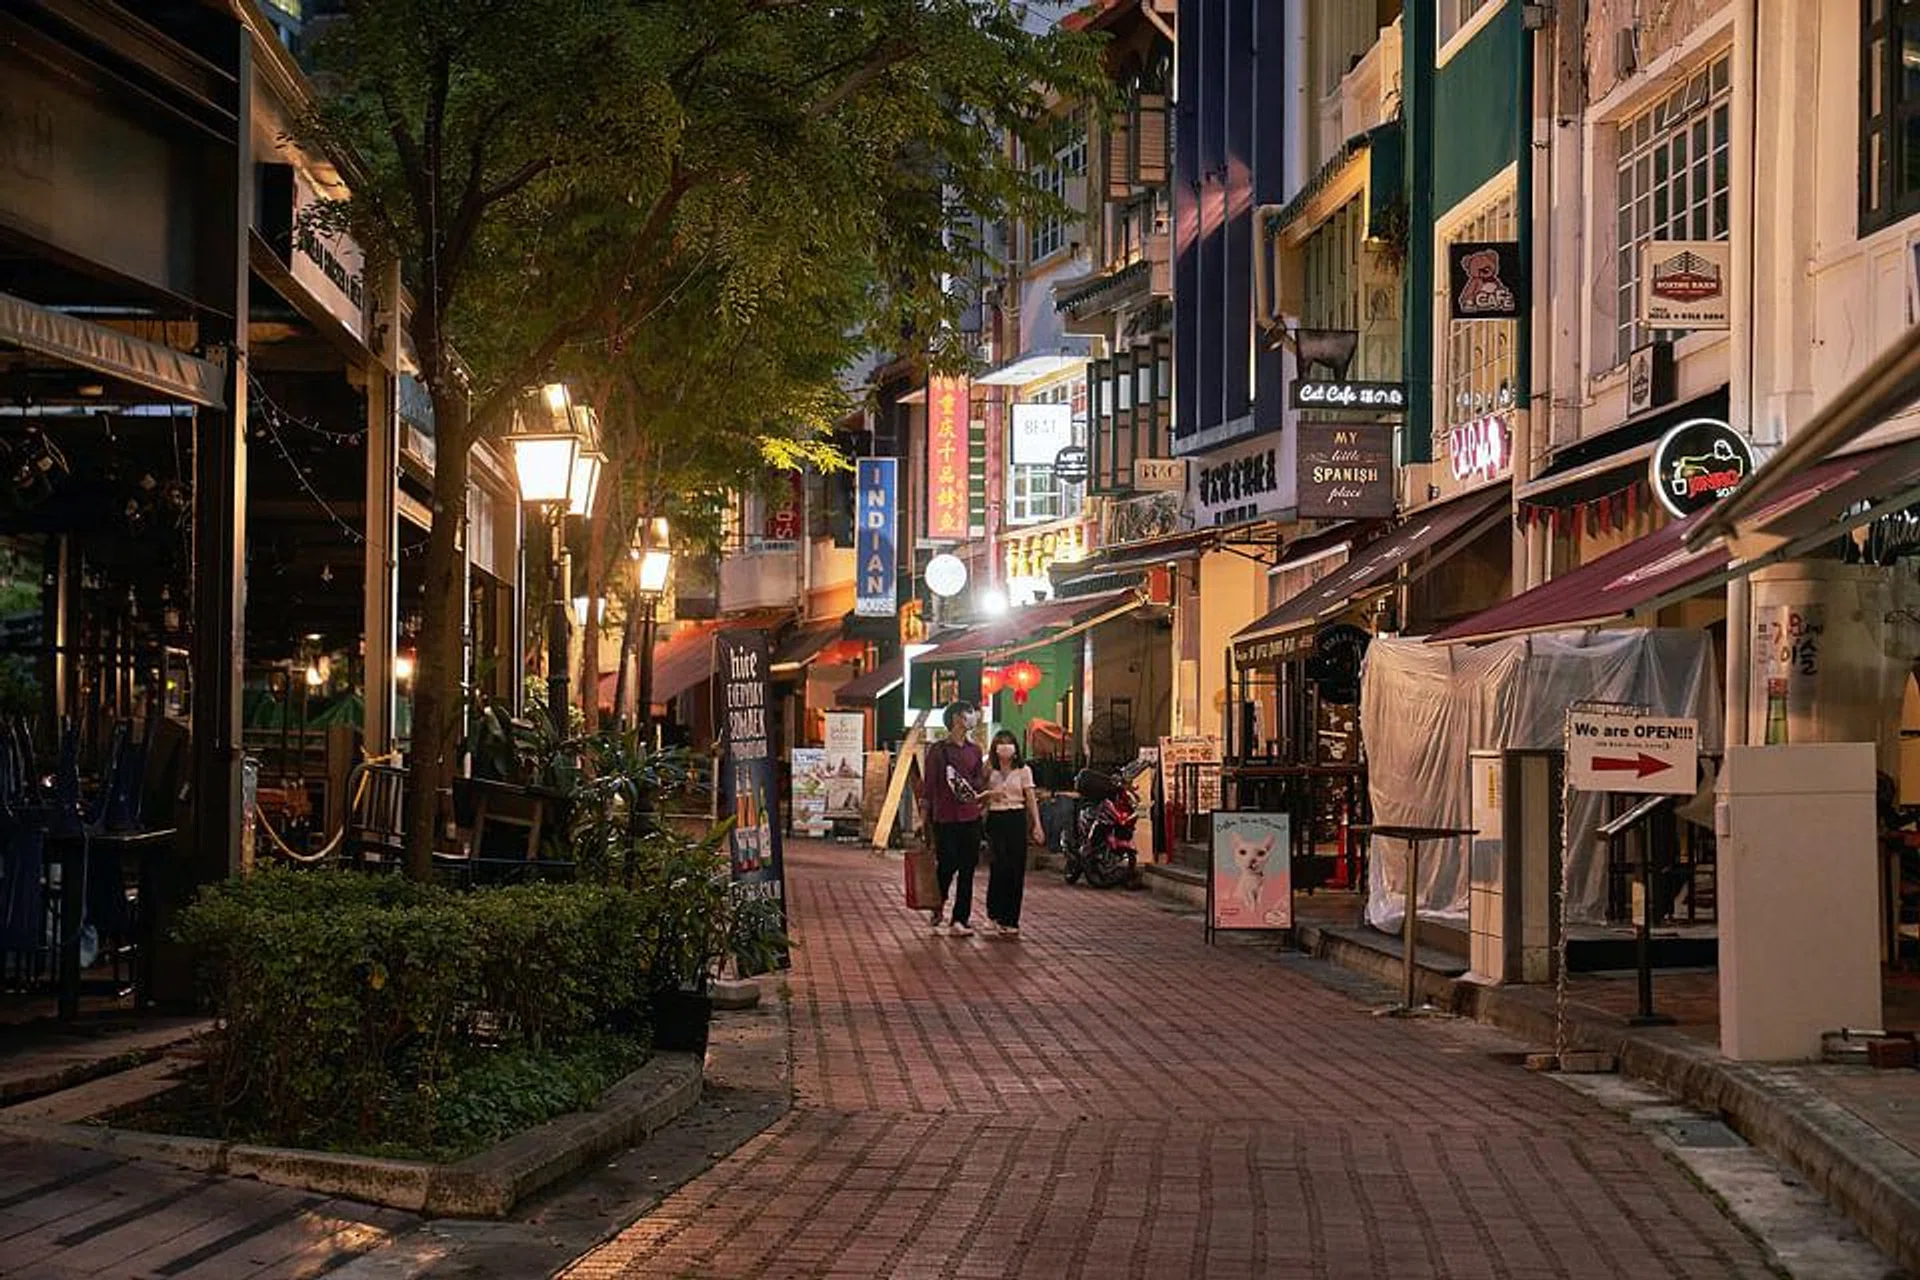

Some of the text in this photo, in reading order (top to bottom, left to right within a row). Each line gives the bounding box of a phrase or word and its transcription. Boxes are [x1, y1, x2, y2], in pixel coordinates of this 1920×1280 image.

[1334, 432, 1357, 444] MY
[1313, 466, 1378, 484] SPANISH
[1327, 486, 1361, 503] place
[867, 467, 886, 594] INDIAN
[1575, 722, 1694, 740] We are OPEN!!!
